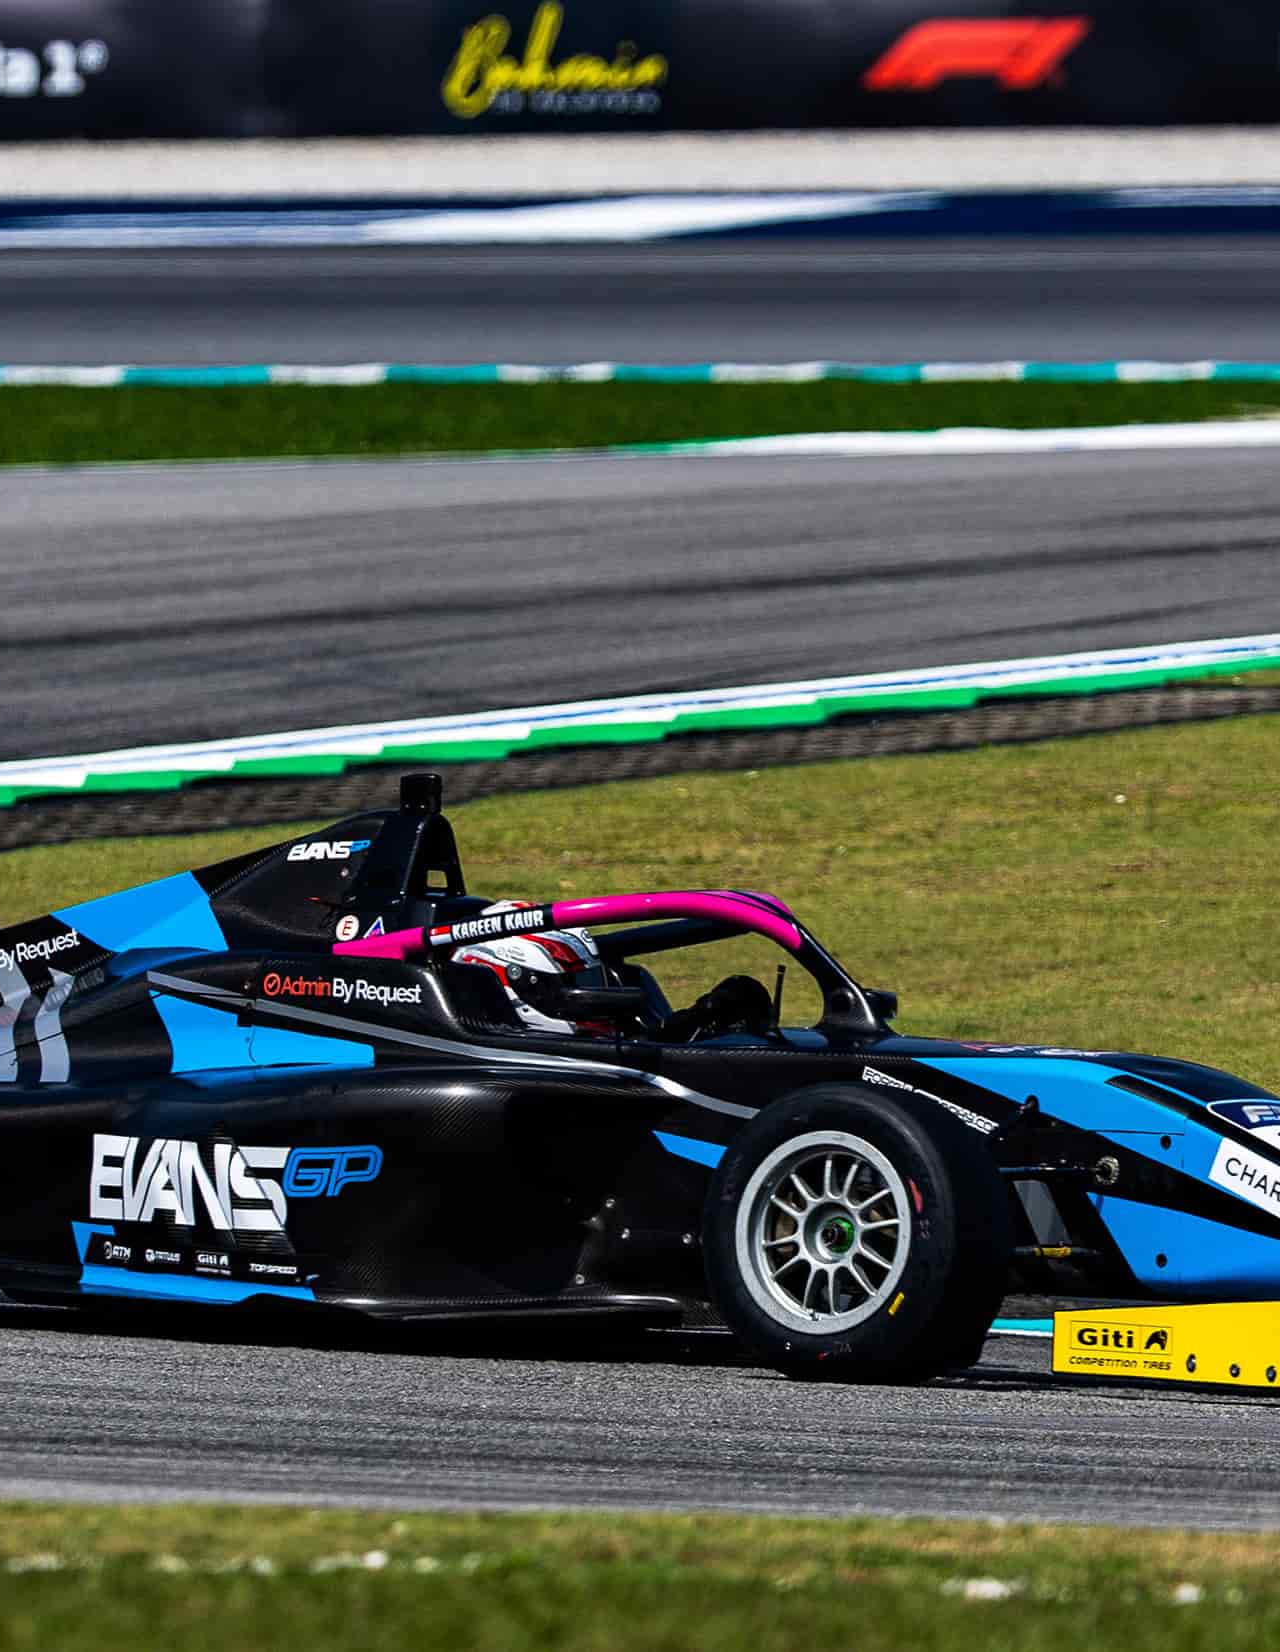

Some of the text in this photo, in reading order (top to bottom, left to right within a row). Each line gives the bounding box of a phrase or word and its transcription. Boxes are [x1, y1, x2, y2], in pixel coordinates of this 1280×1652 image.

[451, 909, 544, 941] KAREEN KAUR
[15, 928, 81, 963] Request
[280, 976, 422, 1007] Admin By Request
[89, 1134, 291, 1230] EVANS
[1077, 1328, 1134, 1348] Giti
[1069, 1356, 1172, 1371] COMPETITION TIRES
